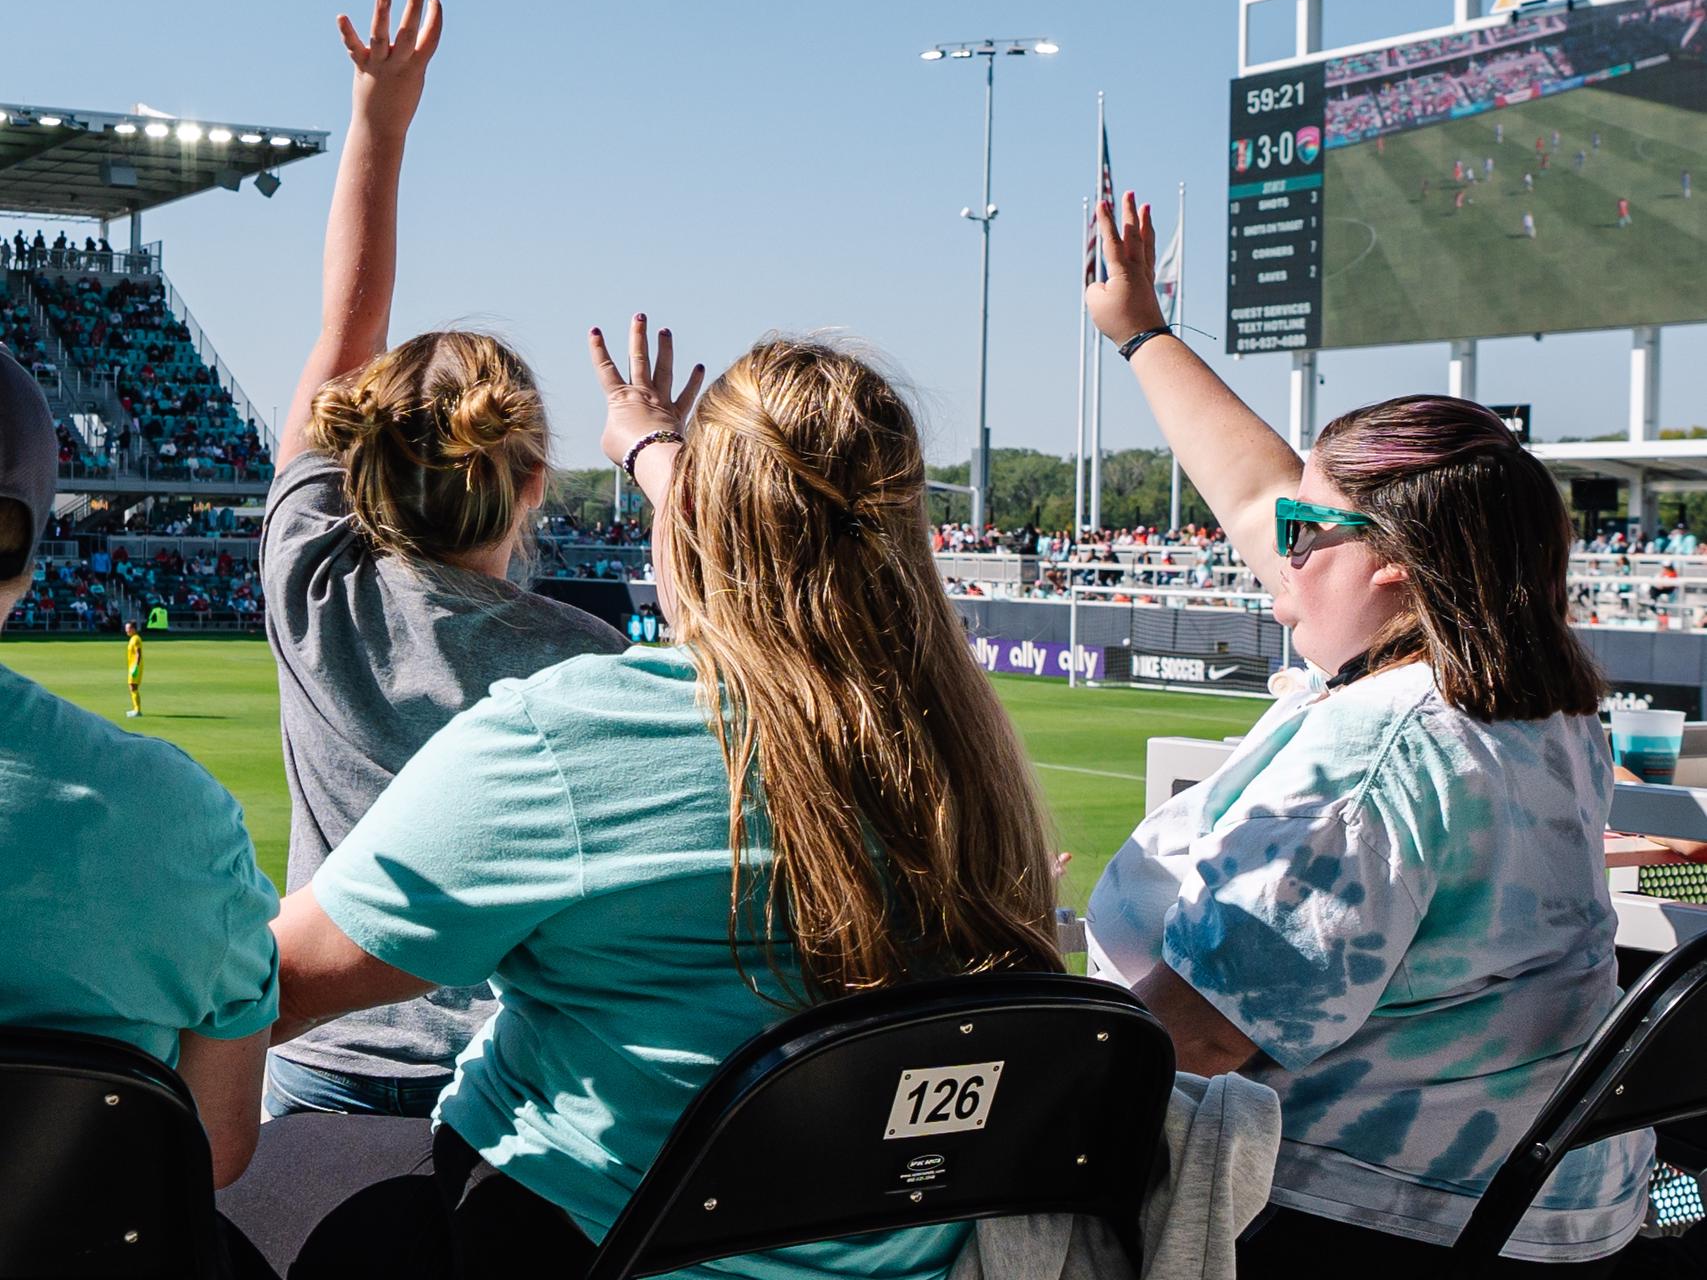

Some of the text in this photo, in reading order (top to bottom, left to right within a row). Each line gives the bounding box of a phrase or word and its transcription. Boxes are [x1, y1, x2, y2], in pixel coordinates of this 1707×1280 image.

[1246, 81, 1304, 114] 59:21
[1257, 131, 1294, 169] 3-0
[1258, 196, 1290, 211] SHOTS
[1311, 191, 1318, 204] 3
[1252, 245, 1295, 260] CORNERS
[1311, 240, 1317, 253] 7
[1231, 265, 1317, 286] 1 SAVES 2
[1231, 302, 1311, 320] GUEST SERVICES
[1237, 317, 1306, 335] TEXT HOTLINE
[1009, 640, 1047, 675] ally
[1058, 644, 1098, 679] ally
[1132, 654, 1205, 682] NIKE SOCCER
[907, 1075, 985, 1125] 126
